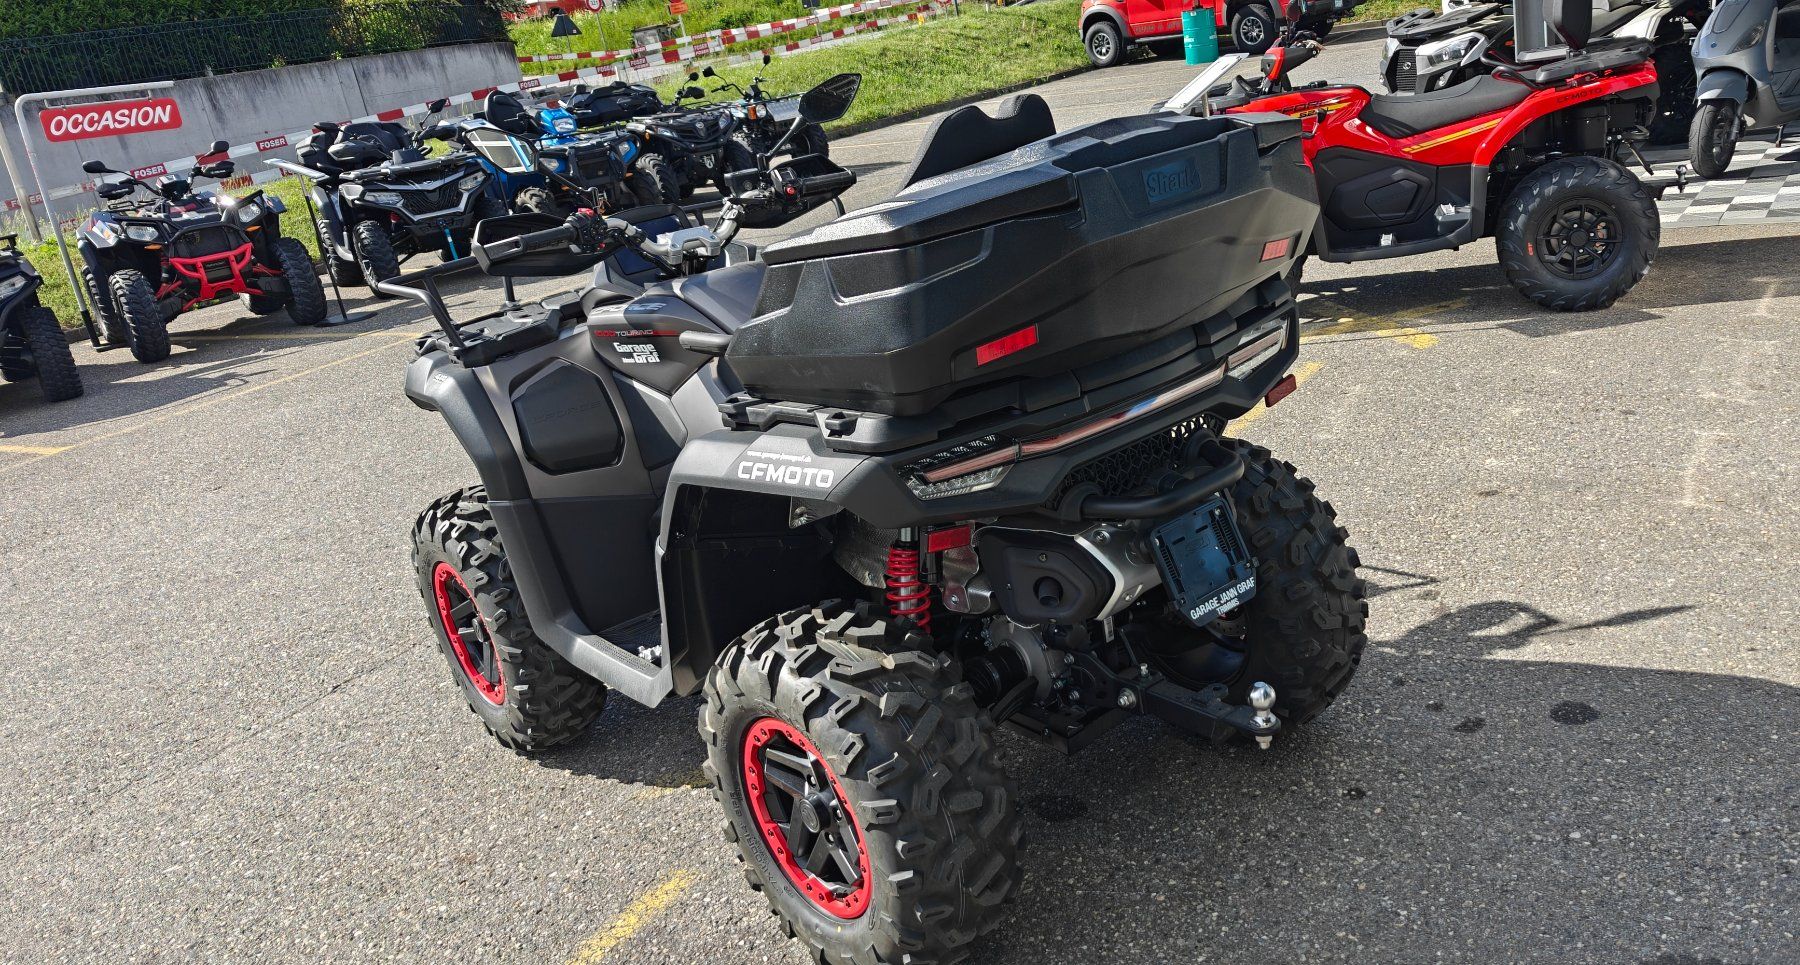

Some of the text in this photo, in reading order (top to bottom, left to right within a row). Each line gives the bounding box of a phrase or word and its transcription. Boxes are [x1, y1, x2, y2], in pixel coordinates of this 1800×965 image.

[519, 80, 539, 90] FOSER
[50, 105, 171, 136] OCCASION
[259, 138, 287, 150] FOSER
[134, 165, 165, 180] FOSER
[1146, 163, 1201, 198] Shark
[613, 342, 656, 355] Garage
[632, 352, 660, 364] Graf
[737, 461, 834, 488] CFMOTO
[1190, 577, 1255, 620] GARAGE JANN GRAF
